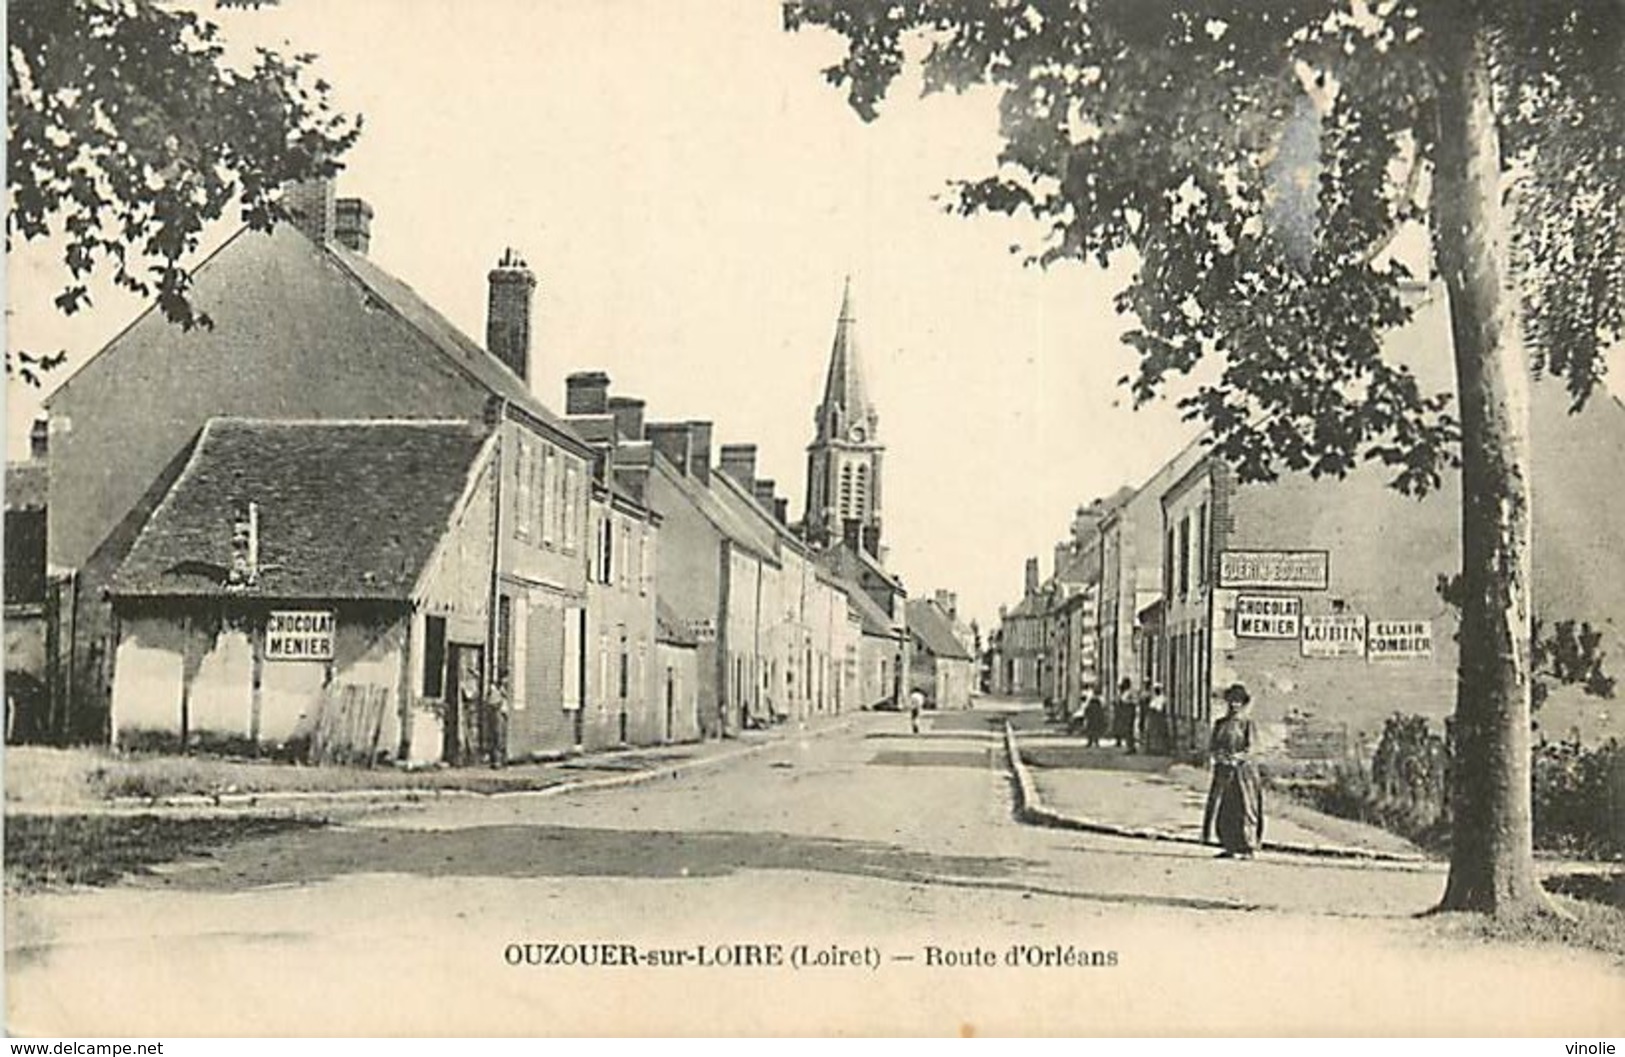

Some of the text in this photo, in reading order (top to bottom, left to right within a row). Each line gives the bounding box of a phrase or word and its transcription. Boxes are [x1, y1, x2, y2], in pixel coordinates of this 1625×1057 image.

[1239, 599, 1298, 615] CHOCOLAT
[268, 615, 333, 632] CHOCOLAT
[1241, 618, 1295, 634] MENIER
[1377, 623, 1424, 635] ELIXIR
[1304, 626, 1363, 642] LUBIN
[270, 638, 330, 654] MENIER
[1370, 637, 1430, 652] COMBIER
